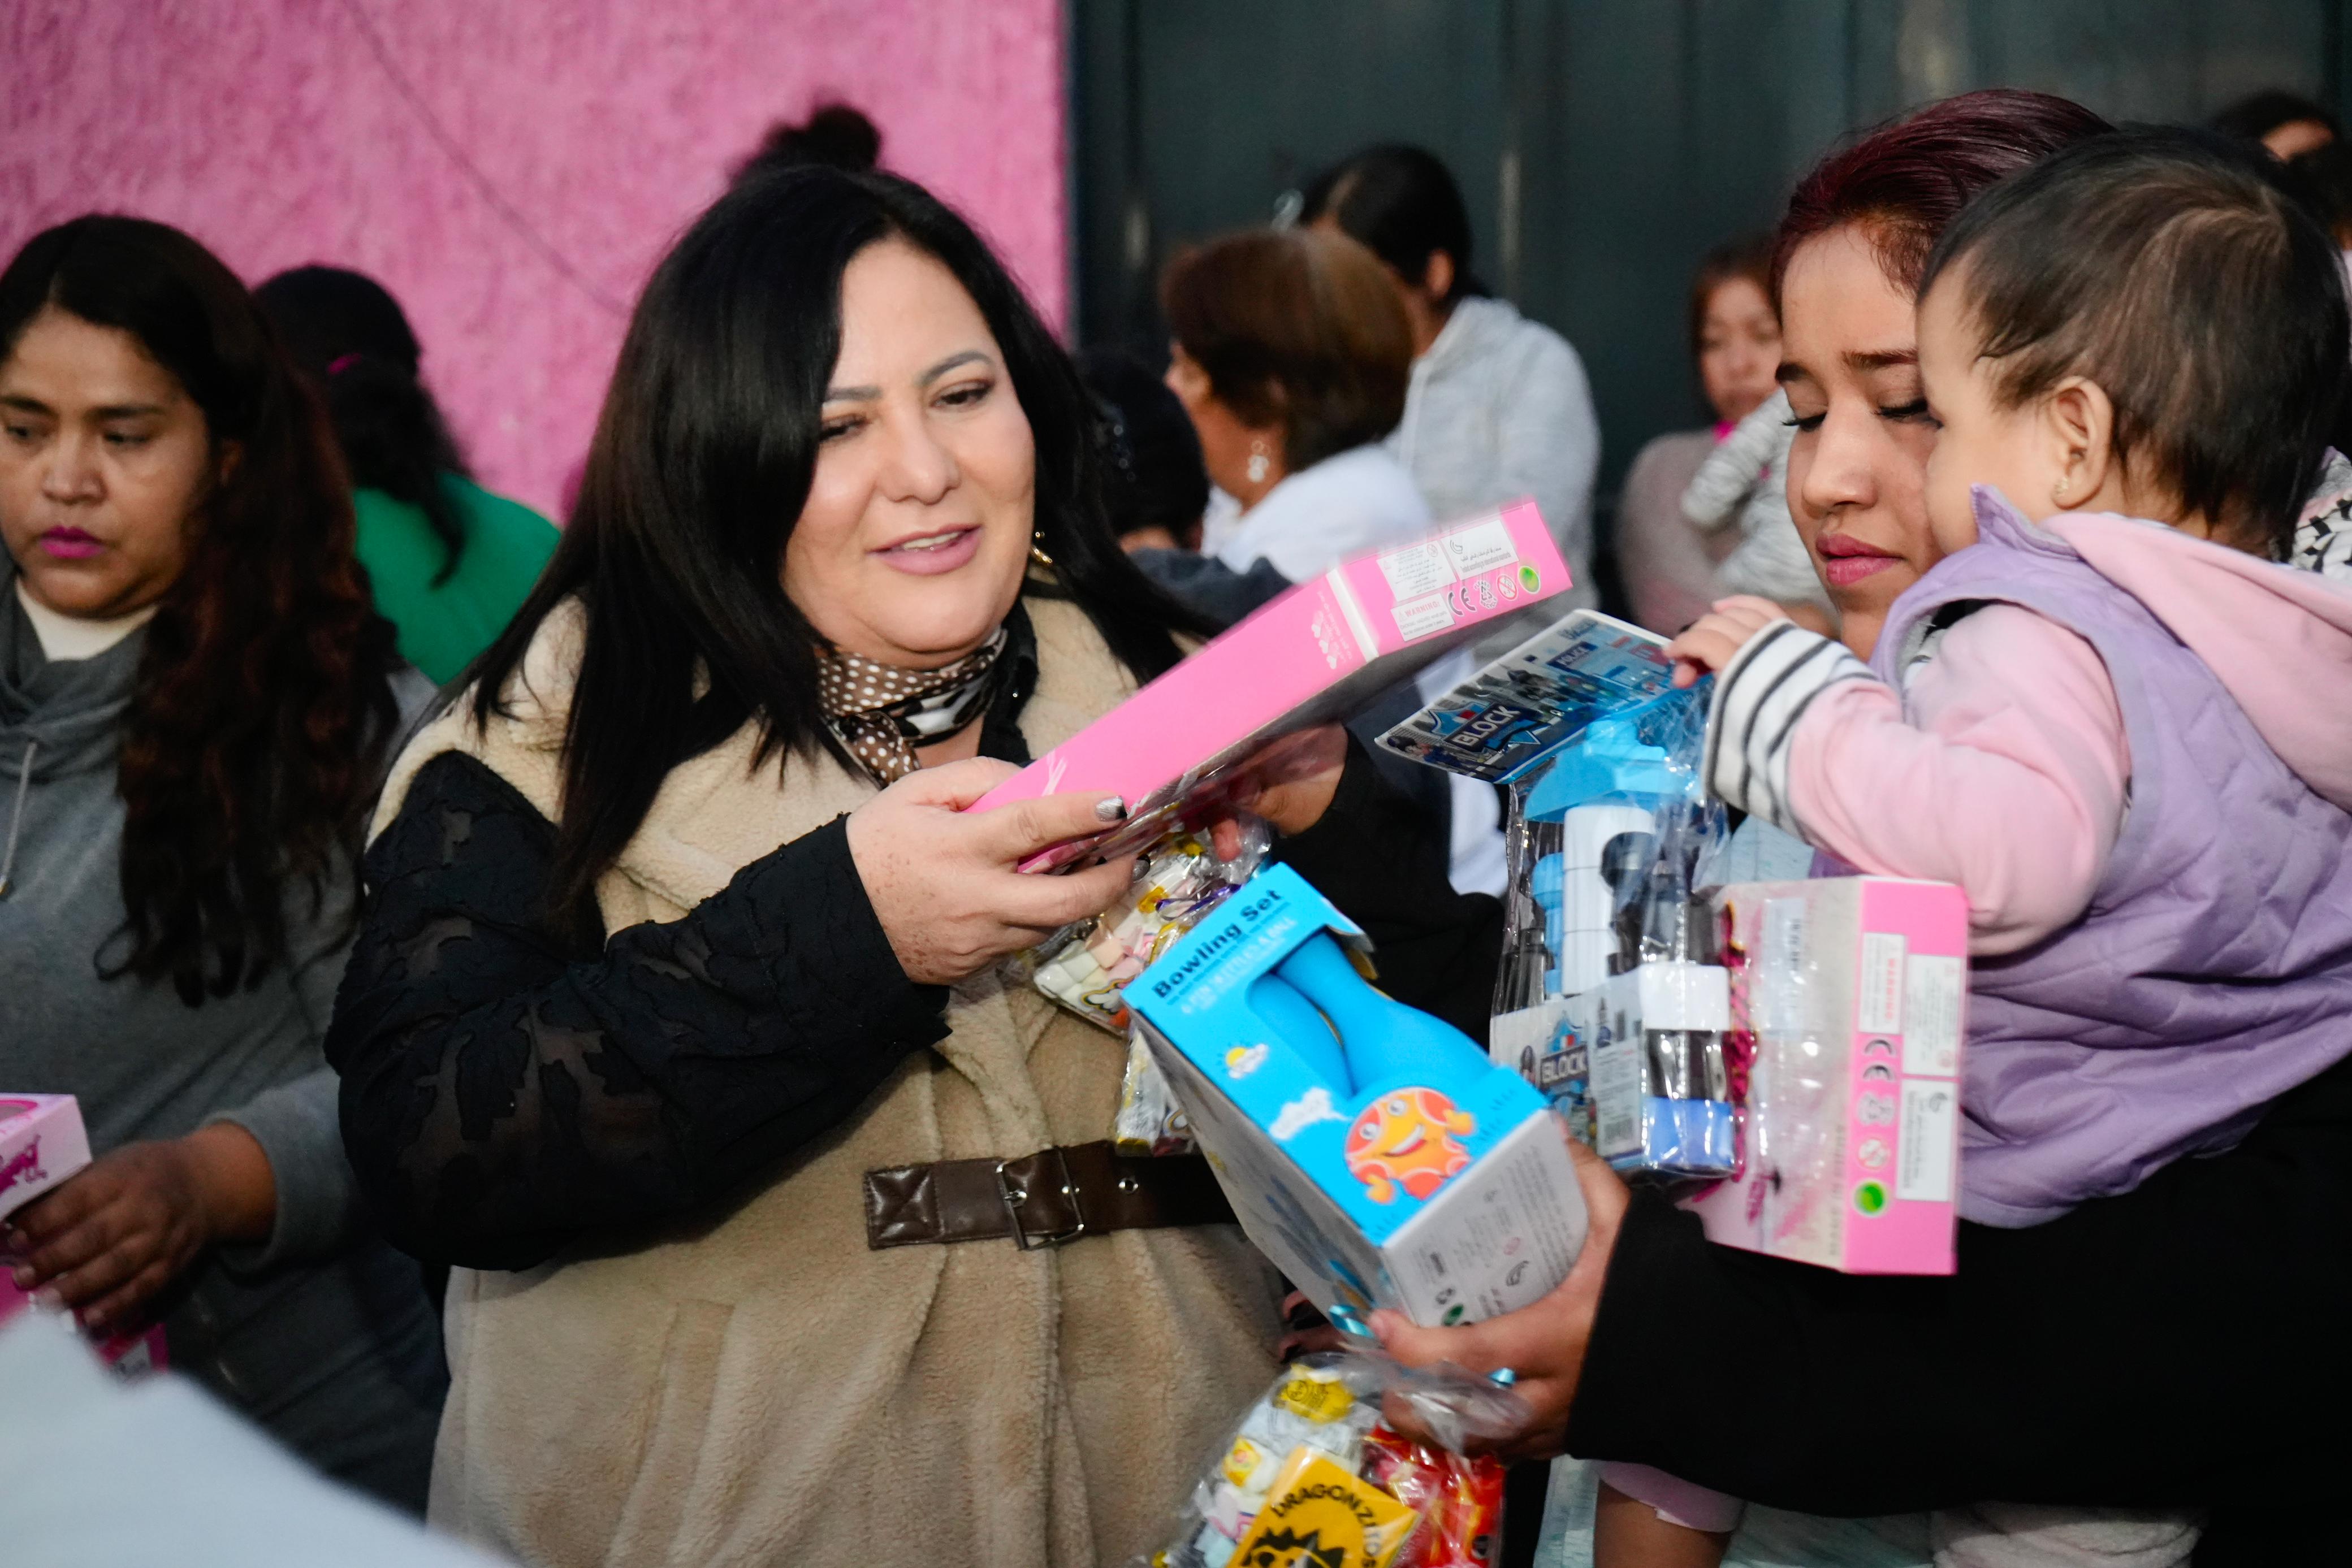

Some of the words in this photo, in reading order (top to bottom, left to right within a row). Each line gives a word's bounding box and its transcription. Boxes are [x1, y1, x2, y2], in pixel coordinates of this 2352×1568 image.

[1452, 705, 1521, 747] BLOCK
[1152, 923, 1242, 998] Bowling
[1240, 889, 1282, 922] Set
